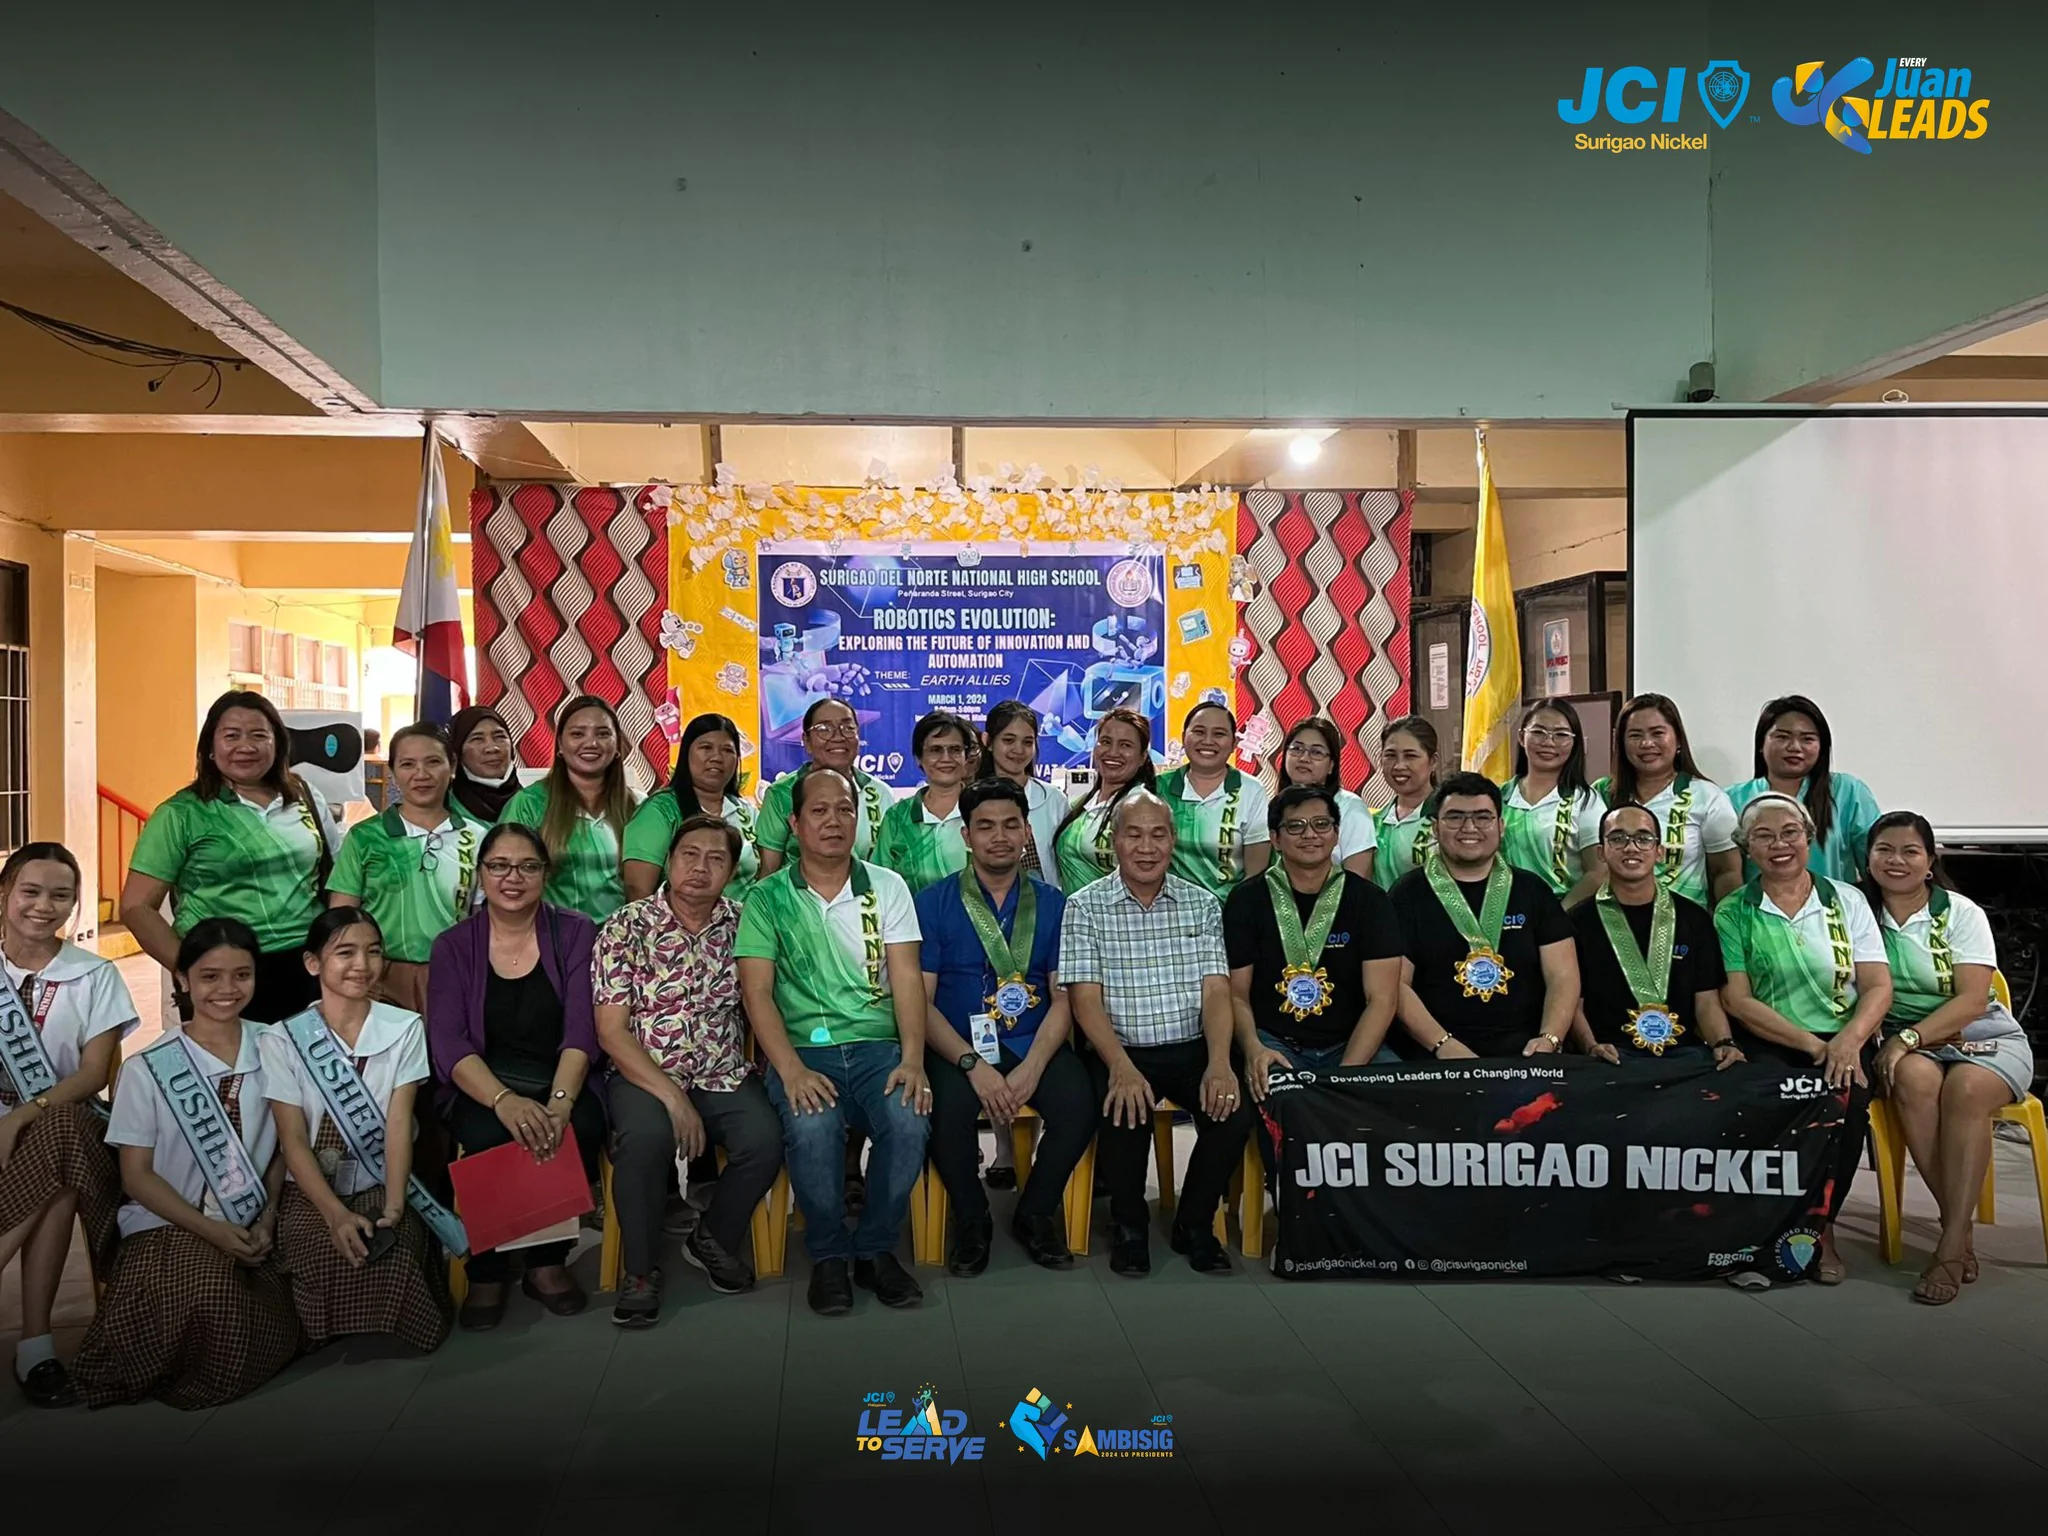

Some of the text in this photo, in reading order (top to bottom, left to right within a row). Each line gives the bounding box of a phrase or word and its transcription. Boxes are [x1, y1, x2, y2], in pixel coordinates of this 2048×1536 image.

[819, 569, 1101, 586] SURIGAO DEL NORTE NATIONAL HIGH SCHOOL
[941, 589, 966, 598] Street,
[967, 590, 997, 599] Surigao
[998, 590, 1014, 599] City
[873, 608, 1056, 630] ROBOTICS EVOLUTION:
[838, 634, 1090, 650] EXPLORING THE FUTURE OF INNOVATION AND
[928, 653, 1004, 669] AUTOMATION
[874, 671, 911, 680] THEME:
[920, 674, 1011, 686] EARTH ALLIES
[928, 694, 987, 705] MARCH 1, 2024
[1661, 790, 1692, 886] SNNHS
[861, 889, 884, 1006] SNNHS
[1930, 915, 1955, 994] SNNH
[1330, 1067, 1564, 1084] Developing Leaders for a Changing World
[1780, 1078, 1822, 1094] JCI
[1296, 1141, 1807, 1196] JCI SURIGAO NICKEL
[1295, 1257, 1397, 1273] jcisurigaonickel.org
[1430, 1258, 1528, 1273] @jcisurigaonickel
